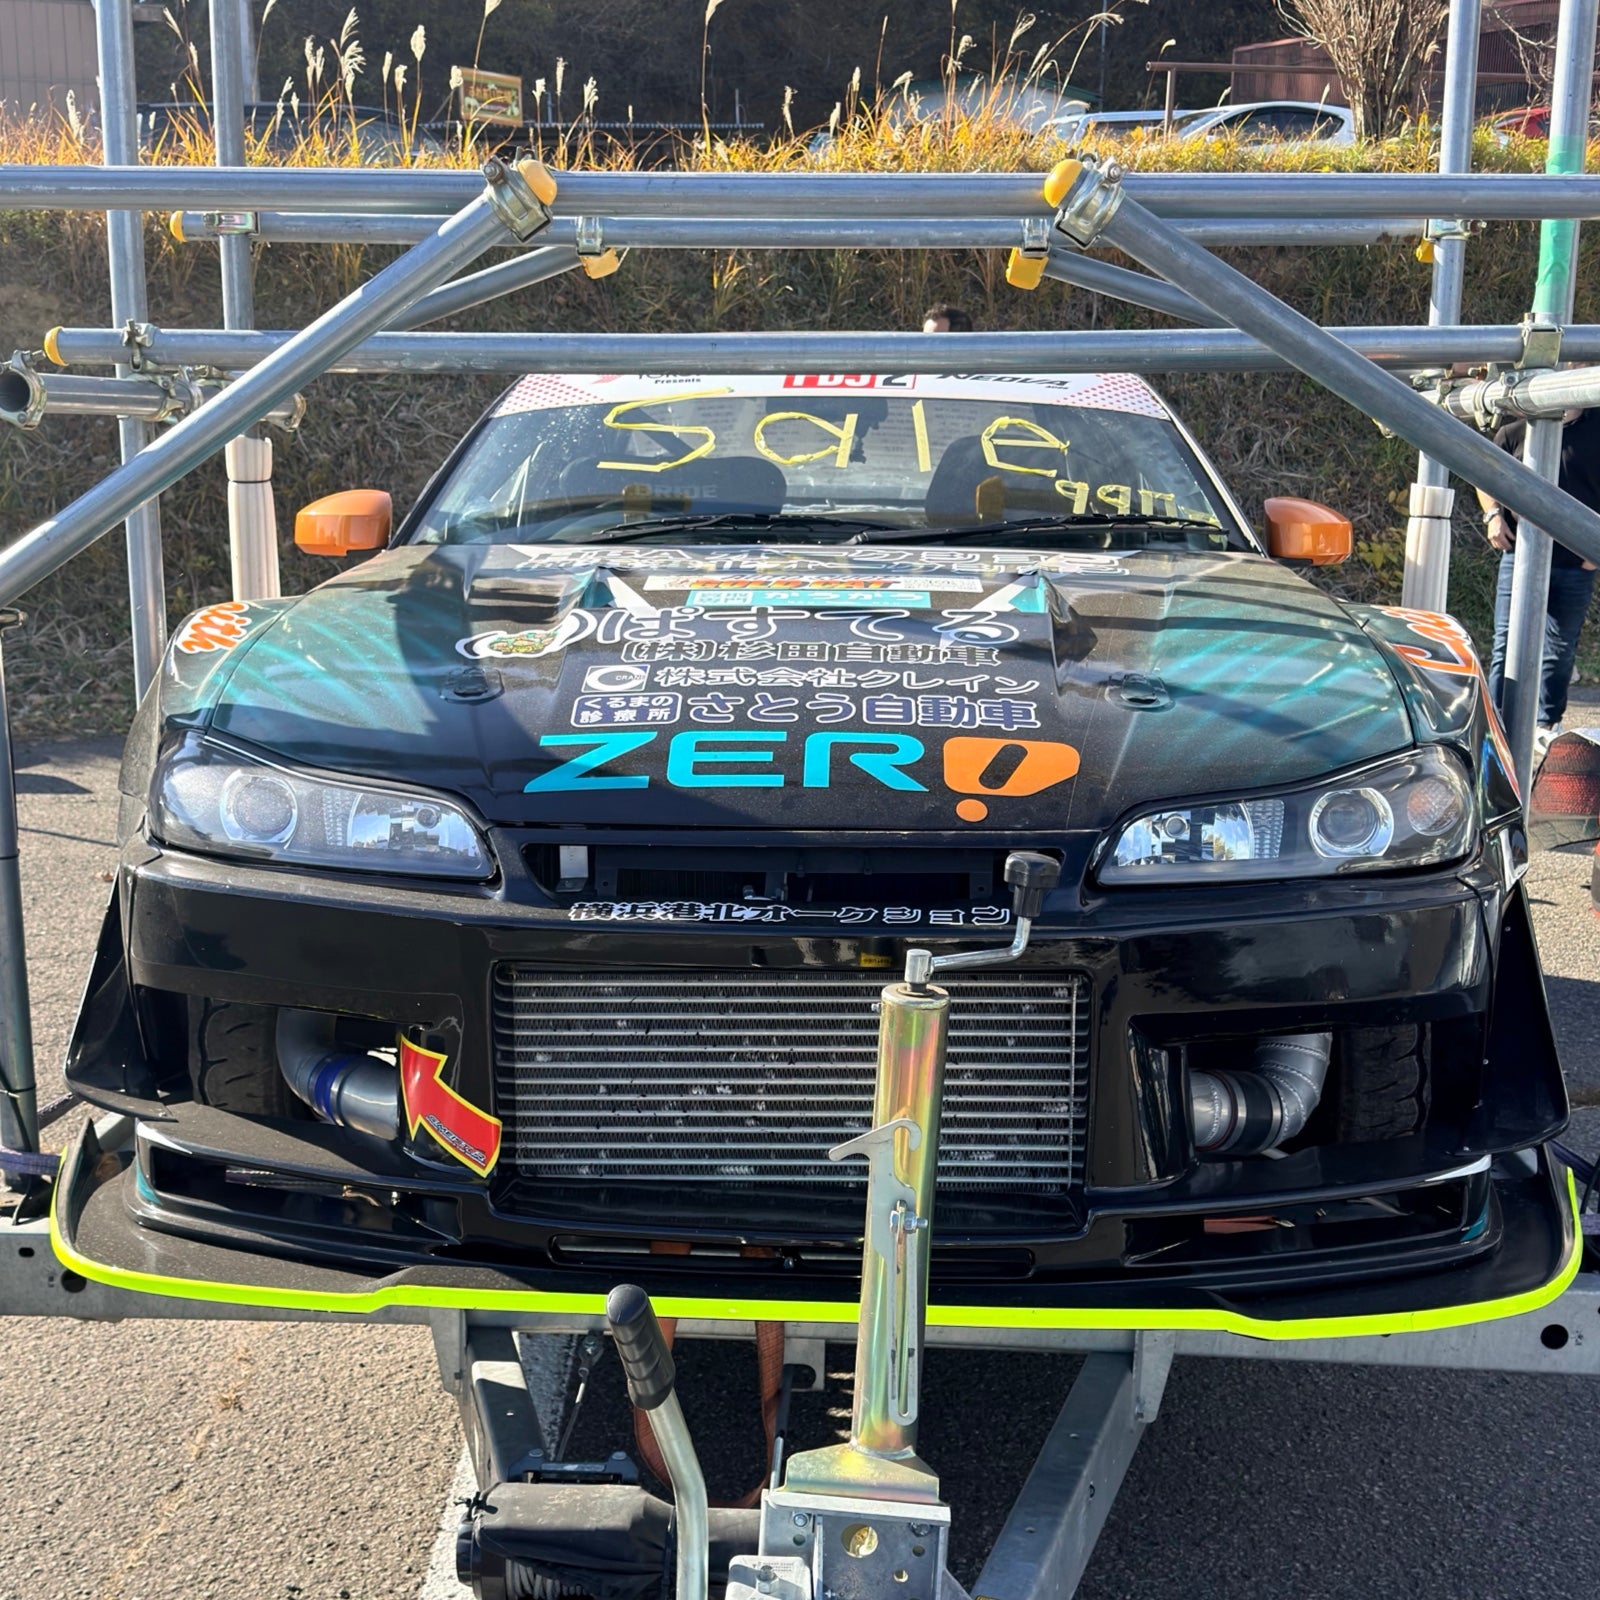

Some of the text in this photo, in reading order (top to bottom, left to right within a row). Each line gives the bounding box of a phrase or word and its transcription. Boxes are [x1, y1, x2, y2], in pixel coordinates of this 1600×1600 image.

[596, 605, 1019, 645] ぱすてる
[654, 666, 1040, 694] 株式会社クレイン
[582, 695, 674, 708] くるまの
[689, 692, 1041, 731] さとう自動車
[579, 709, 671, 724] 診療所
[568, 900, 1011, 925] 横浜港北オークション
